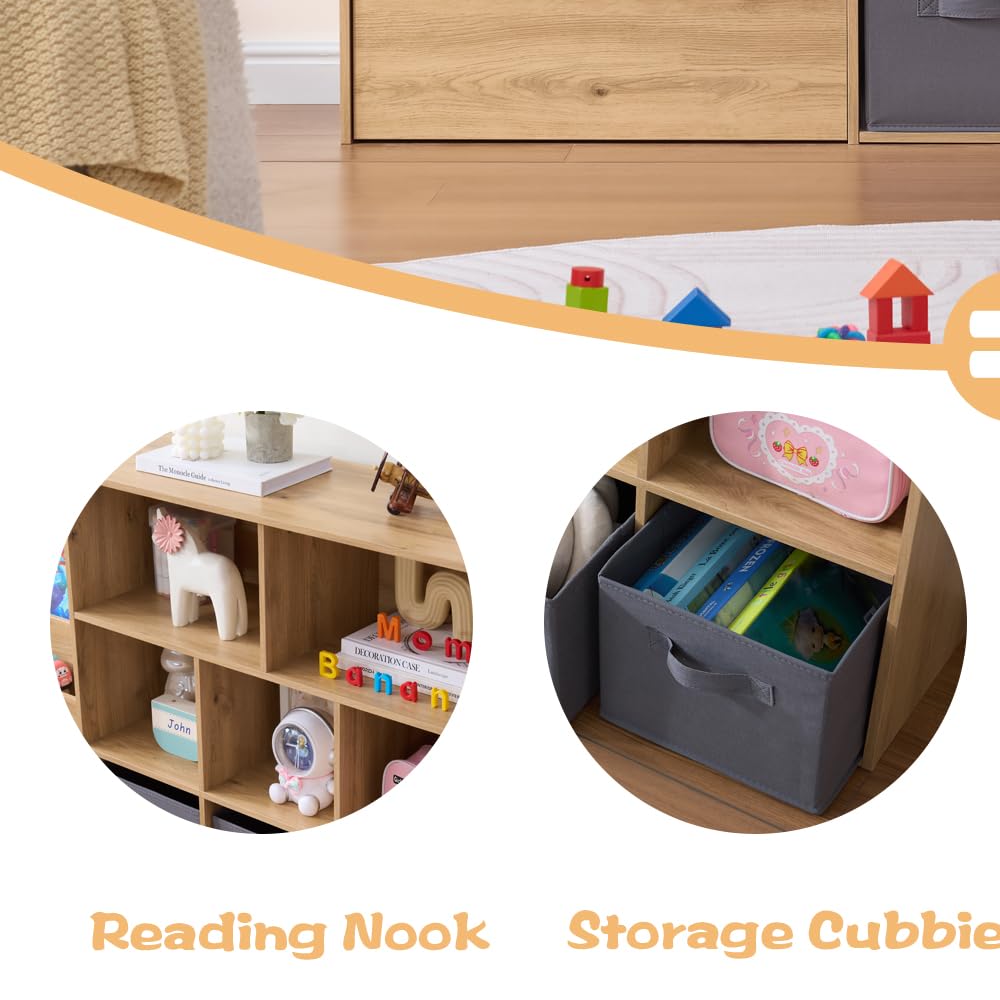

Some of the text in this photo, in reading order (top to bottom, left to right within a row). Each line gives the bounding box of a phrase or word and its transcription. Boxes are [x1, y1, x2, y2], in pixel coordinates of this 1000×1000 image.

[354, 646, 421, 673] DECORATION CASE
[168, 719, 191, 735] John
